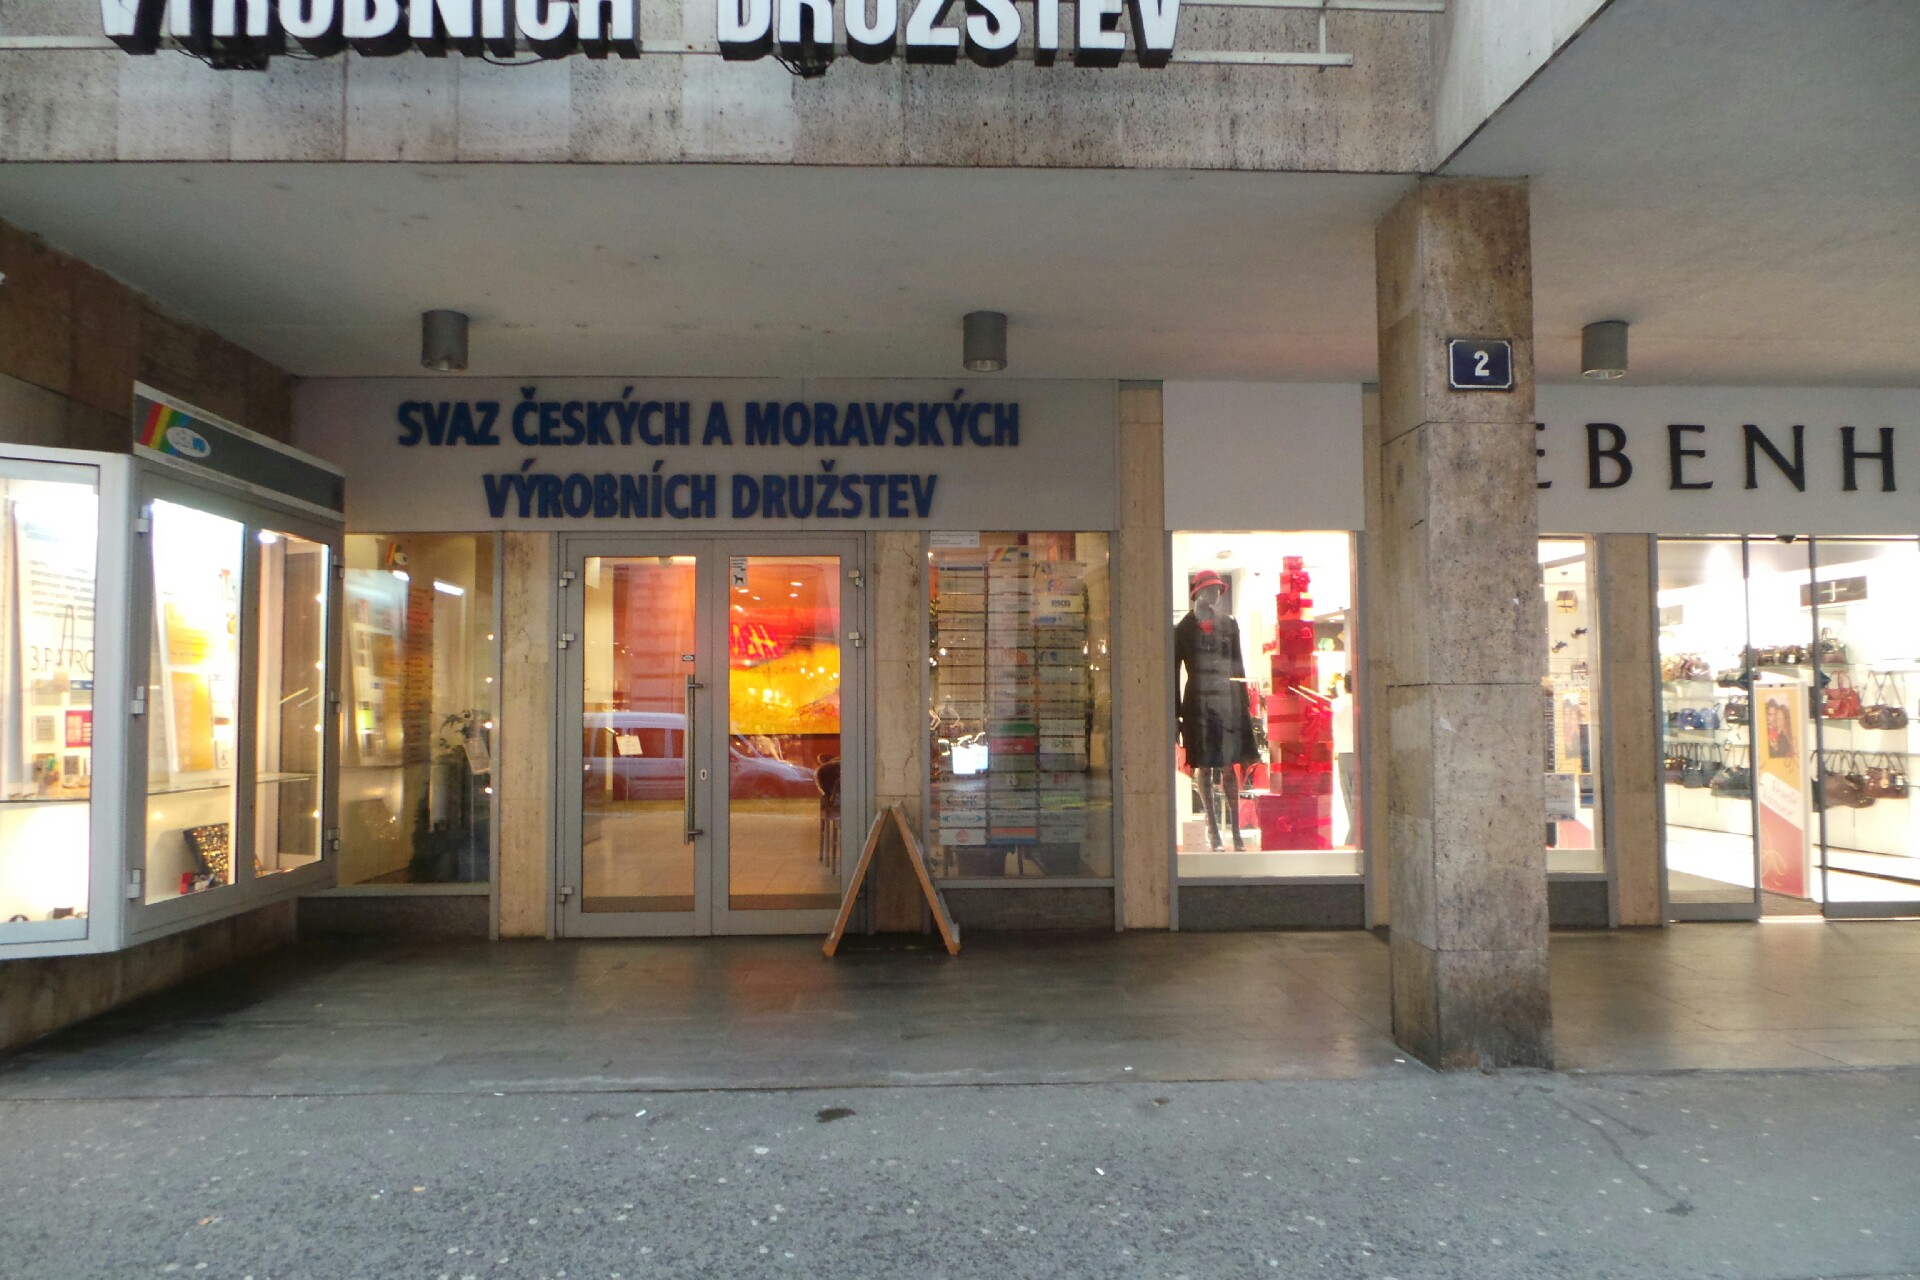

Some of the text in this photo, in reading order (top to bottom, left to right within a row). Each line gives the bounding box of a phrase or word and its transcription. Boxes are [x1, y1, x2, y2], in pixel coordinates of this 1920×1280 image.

[1473, 350, 1490, 377] 2
[398, 386, 1020, 447] SVAZ ČESKÝCH A MORAVSKÝCH
[482, 458, 938, 519] VÝROBNÍCH DRUŽSTEV
